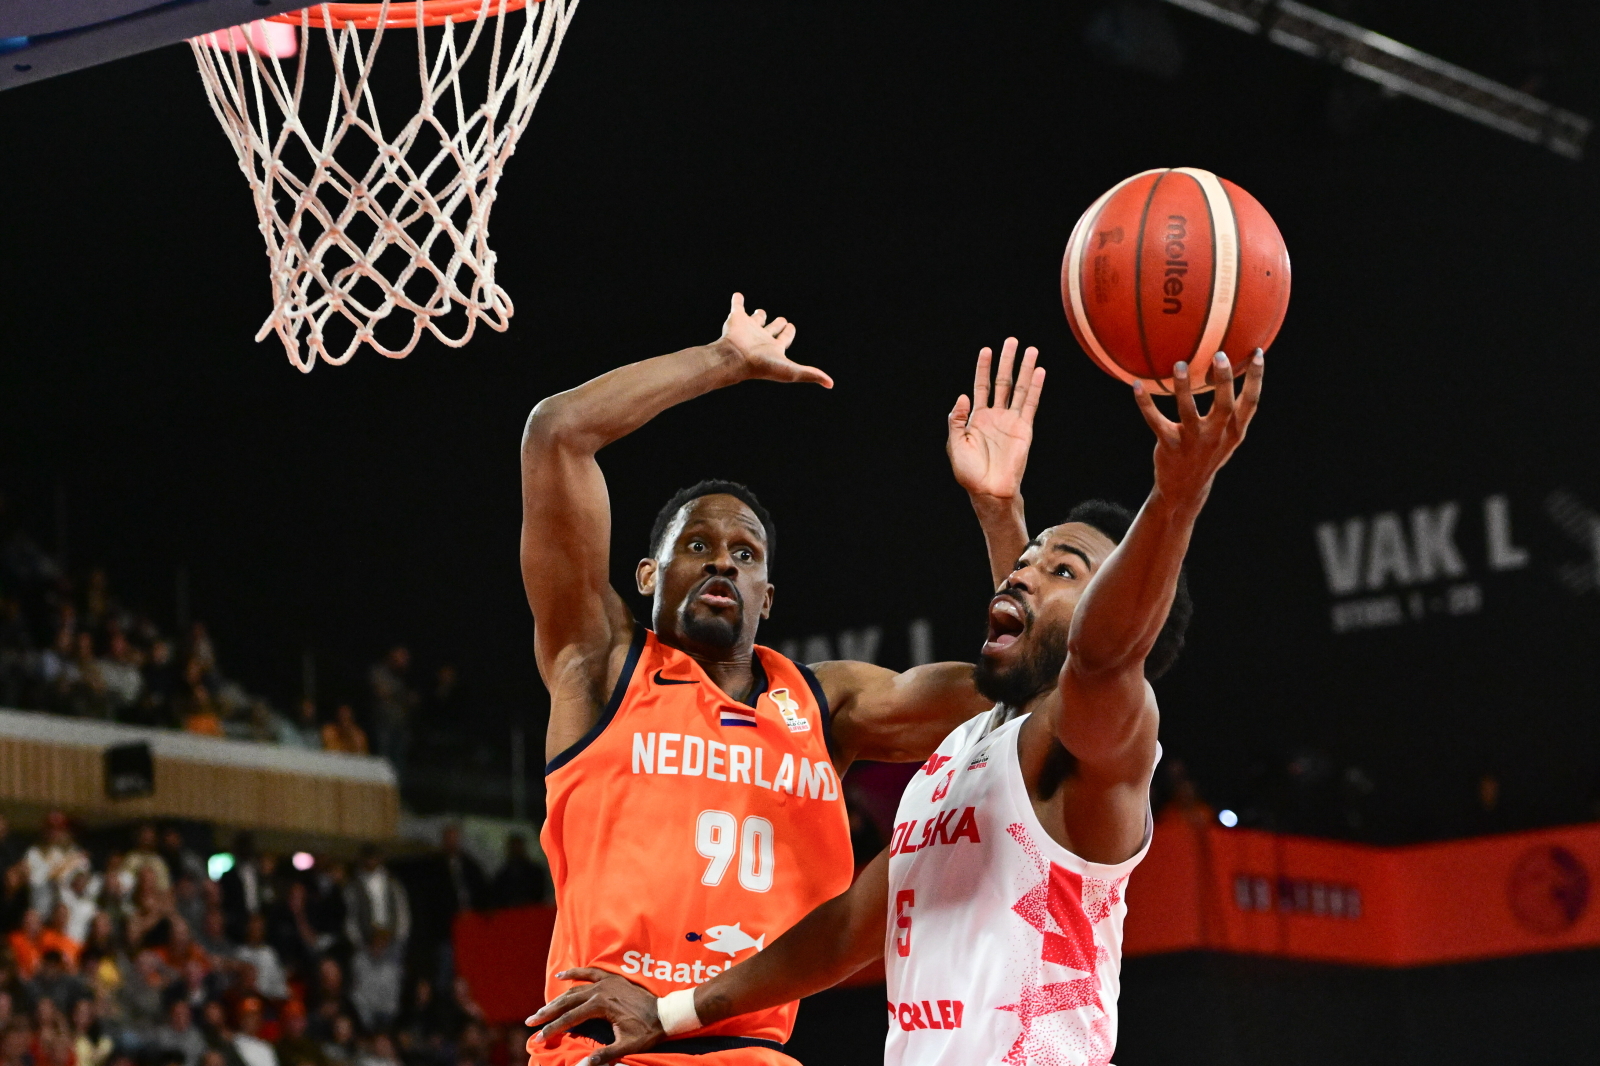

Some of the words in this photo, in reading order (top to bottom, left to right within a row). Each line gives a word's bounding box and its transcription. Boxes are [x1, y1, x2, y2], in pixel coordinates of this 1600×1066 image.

[1162, 214, 1189, 316] molten
[1315, 503, 1466, 595] VAK
[1484, 494, 1530, 570] L
[631, 731, 839, 801] NEDERLAND
[694, 808, 775, 893] 90
[889, 806, 982, 859] OLSKA
[896, 888, 916, 958] 5
